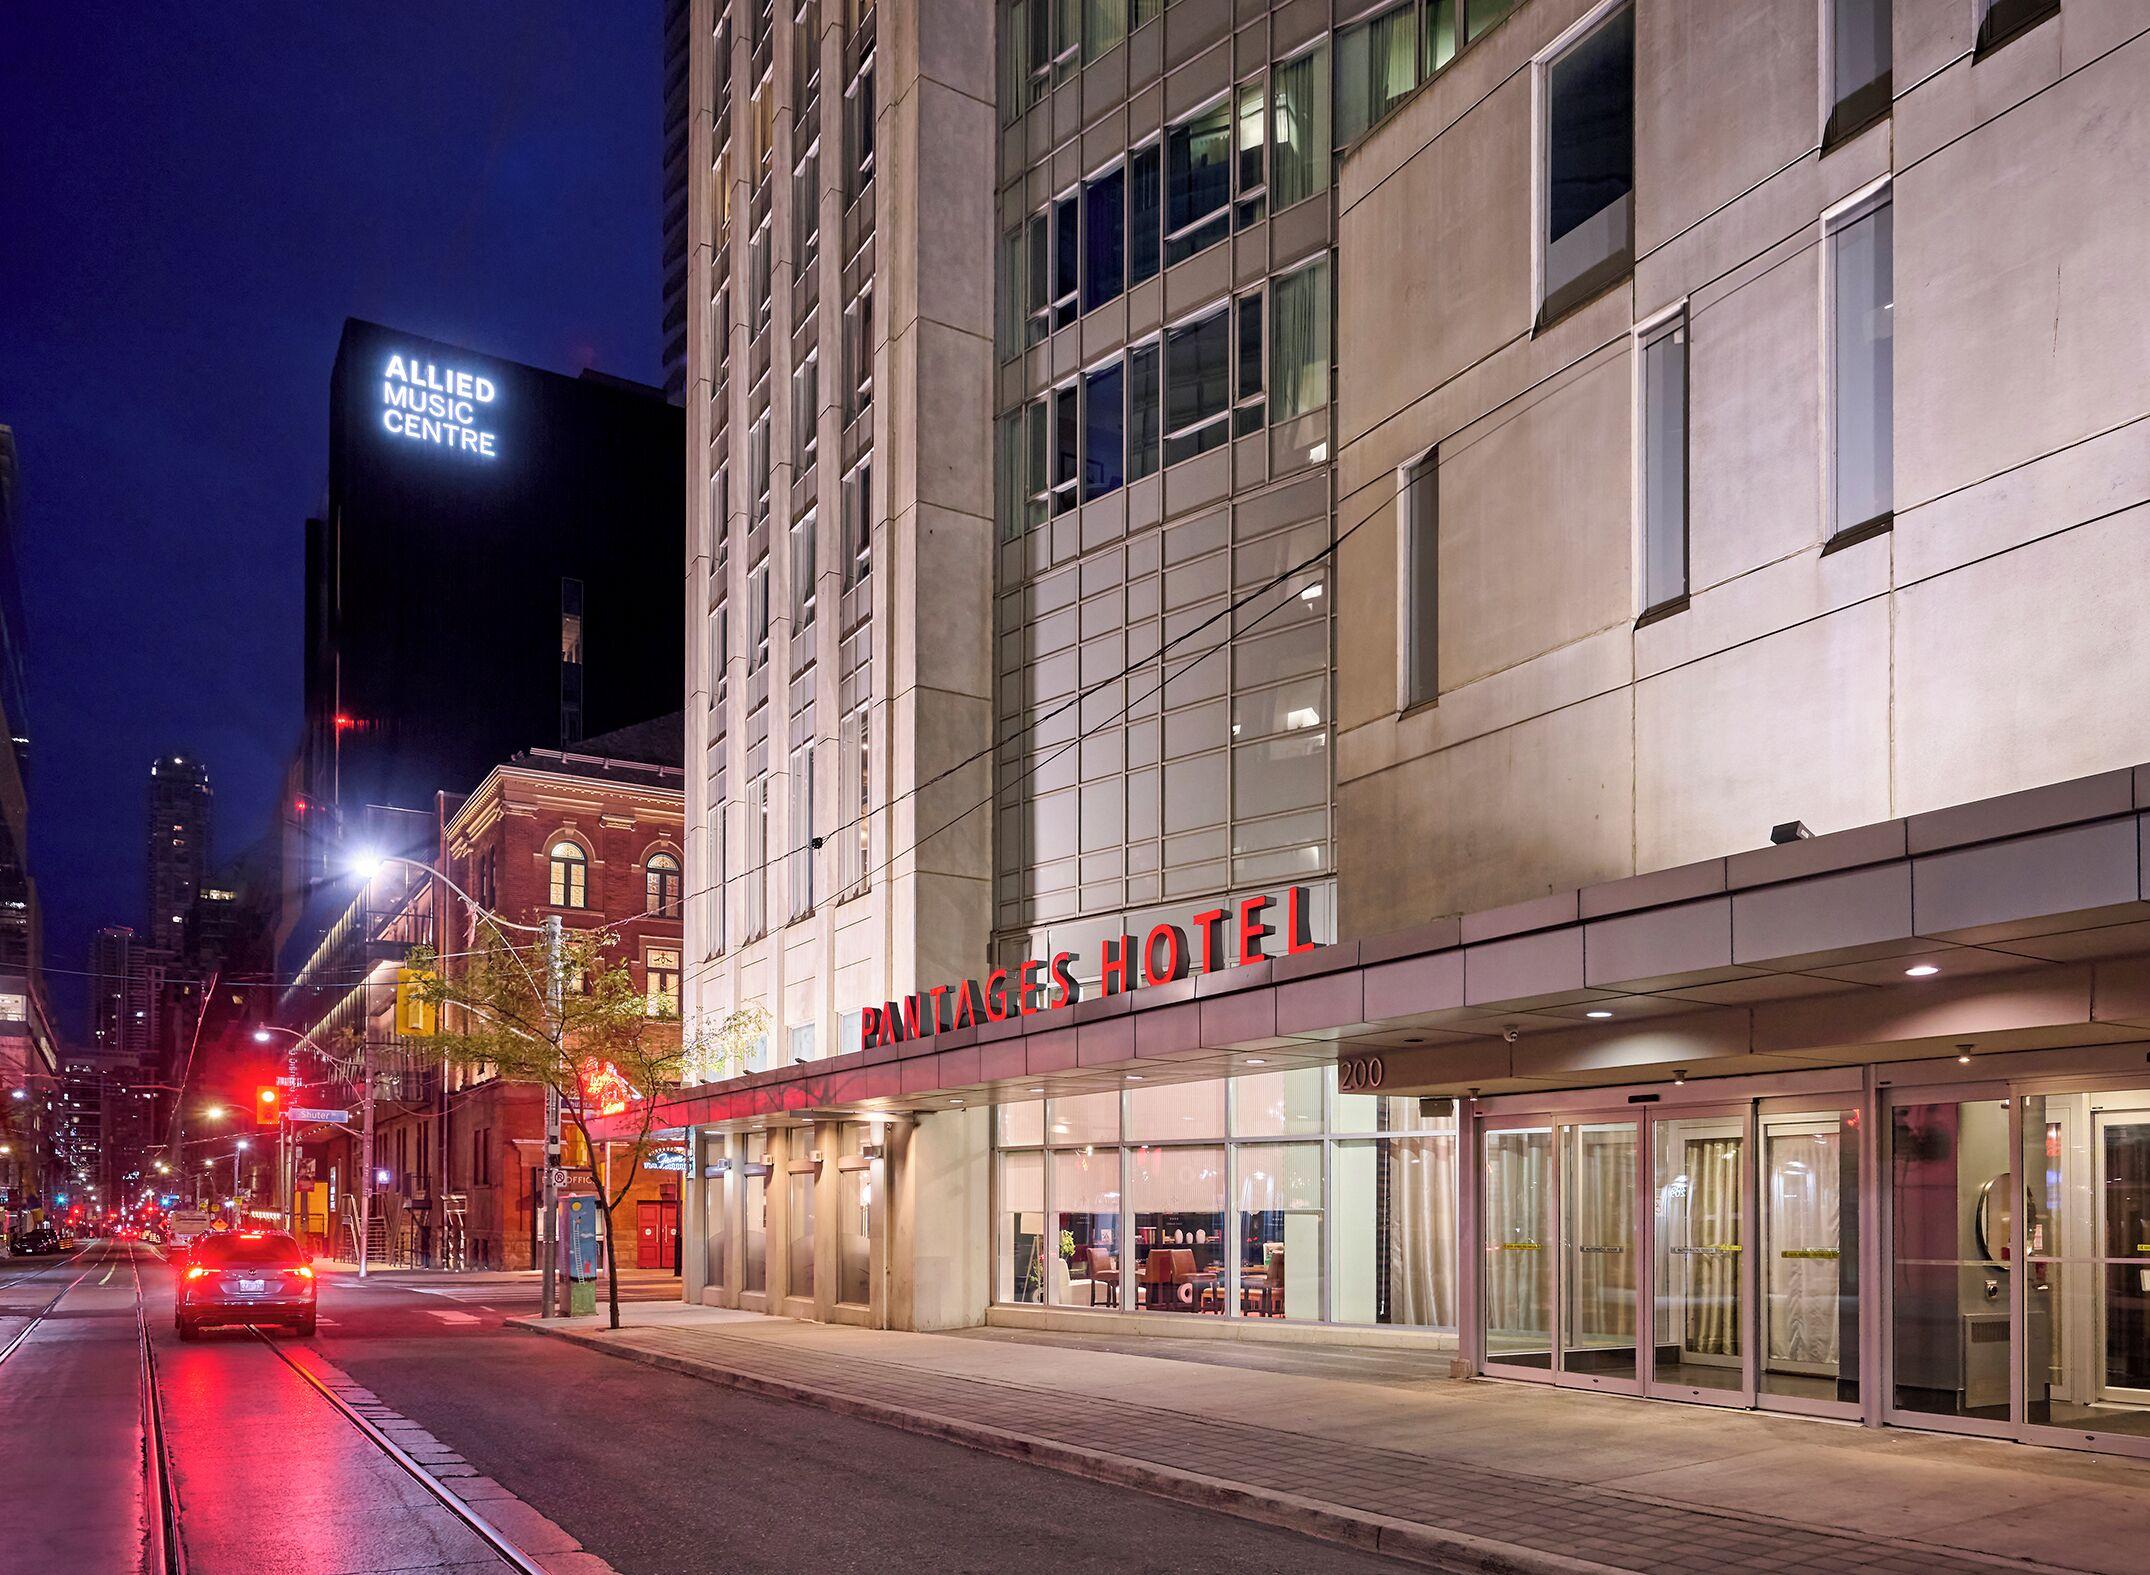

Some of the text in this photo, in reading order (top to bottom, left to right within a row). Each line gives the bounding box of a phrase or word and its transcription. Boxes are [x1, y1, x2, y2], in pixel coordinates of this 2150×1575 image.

[385, 355, 495, 402] ALLIED
[384, 381, 474, 424] MUSIC
[383, 409, 496, 457] CENTRE
[861, 886, 1322, 1051] PANTAGES HOTEL
[1340, 1057, 1384, 1092] 200
[300, 1110, 330, 1120] Shuter
[566, 1176, 595, 1185] OFFIC
